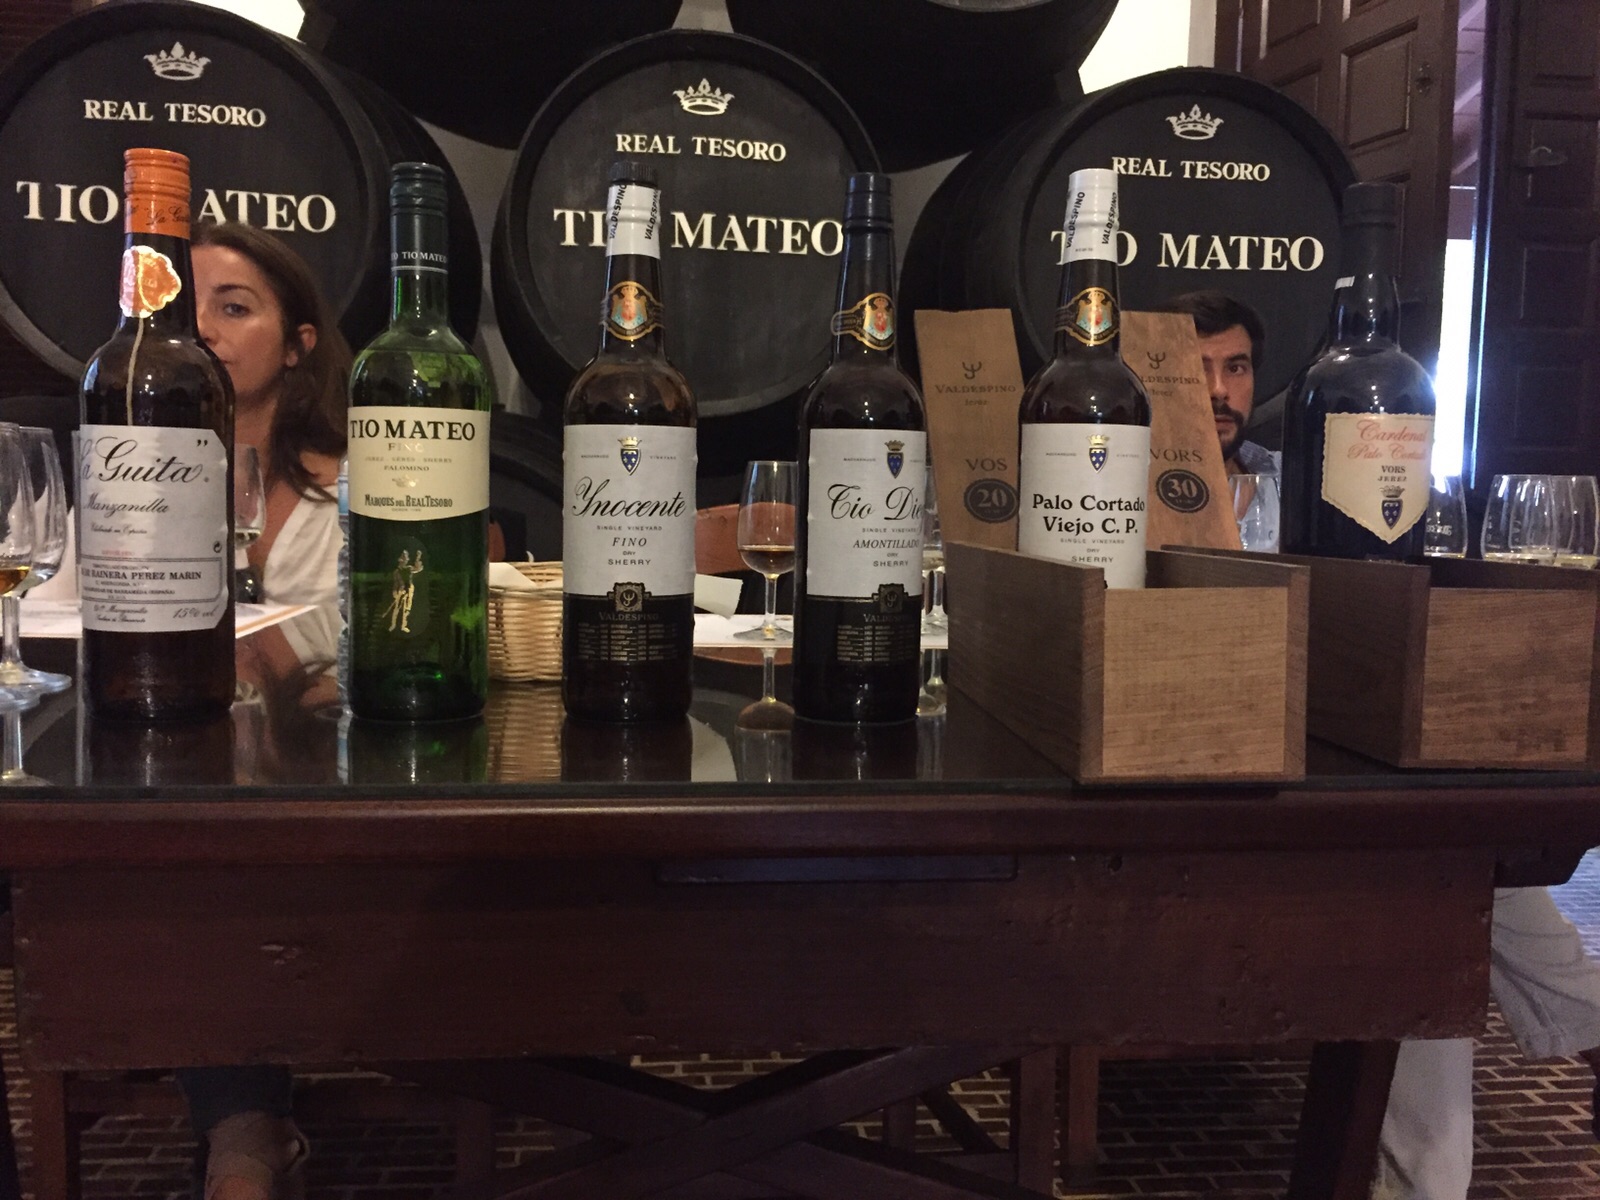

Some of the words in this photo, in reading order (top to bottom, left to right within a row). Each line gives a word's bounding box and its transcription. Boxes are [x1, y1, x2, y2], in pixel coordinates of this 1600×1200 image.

[84, 99, 153, 121] REAL
[164, 103, 266, 128] TESORO
[615, 133, 681, 154] REAL
[692, 136, 786, 162] TESORO
[1111, 156, 1172, 177] REAL
[1180, 161, 1270, 182] TESORO
[198, 189, 336, 233] ATEO
[1066, 191, 1085, 249] VALDESPINO
[553, 208, 606, 247] TI
[670, 211, 844, 256] MATEO
[1157, 233, 1324, 272] MATEO
[935, 384, 1016, 394] VALDESPINO
[350, 419, 380, 439] TIO
[384, 419, 476, 441] MATEO
[965, 457, 1008, 473] VOS
[1150, 449, 1203, 463] VORS
[1381, 464, 1406, 474] VORS
[977, 489, 1007, 507] 20
[1167, 478, 1198, 498] 30
[83, 493, 169, 518] Manzanilla
[1032, 493, 1073, 510] Palo
[1080, 494, 1145, 512] Cortado
[1043, 516, 1094, 536] Viejo
[1101, 518, 1120, 534] C.
[1125, 518, 1138, 534] P.
[612, 537, 647, 547] FINO
[1072, 555, 1114, 564] SHERRY
